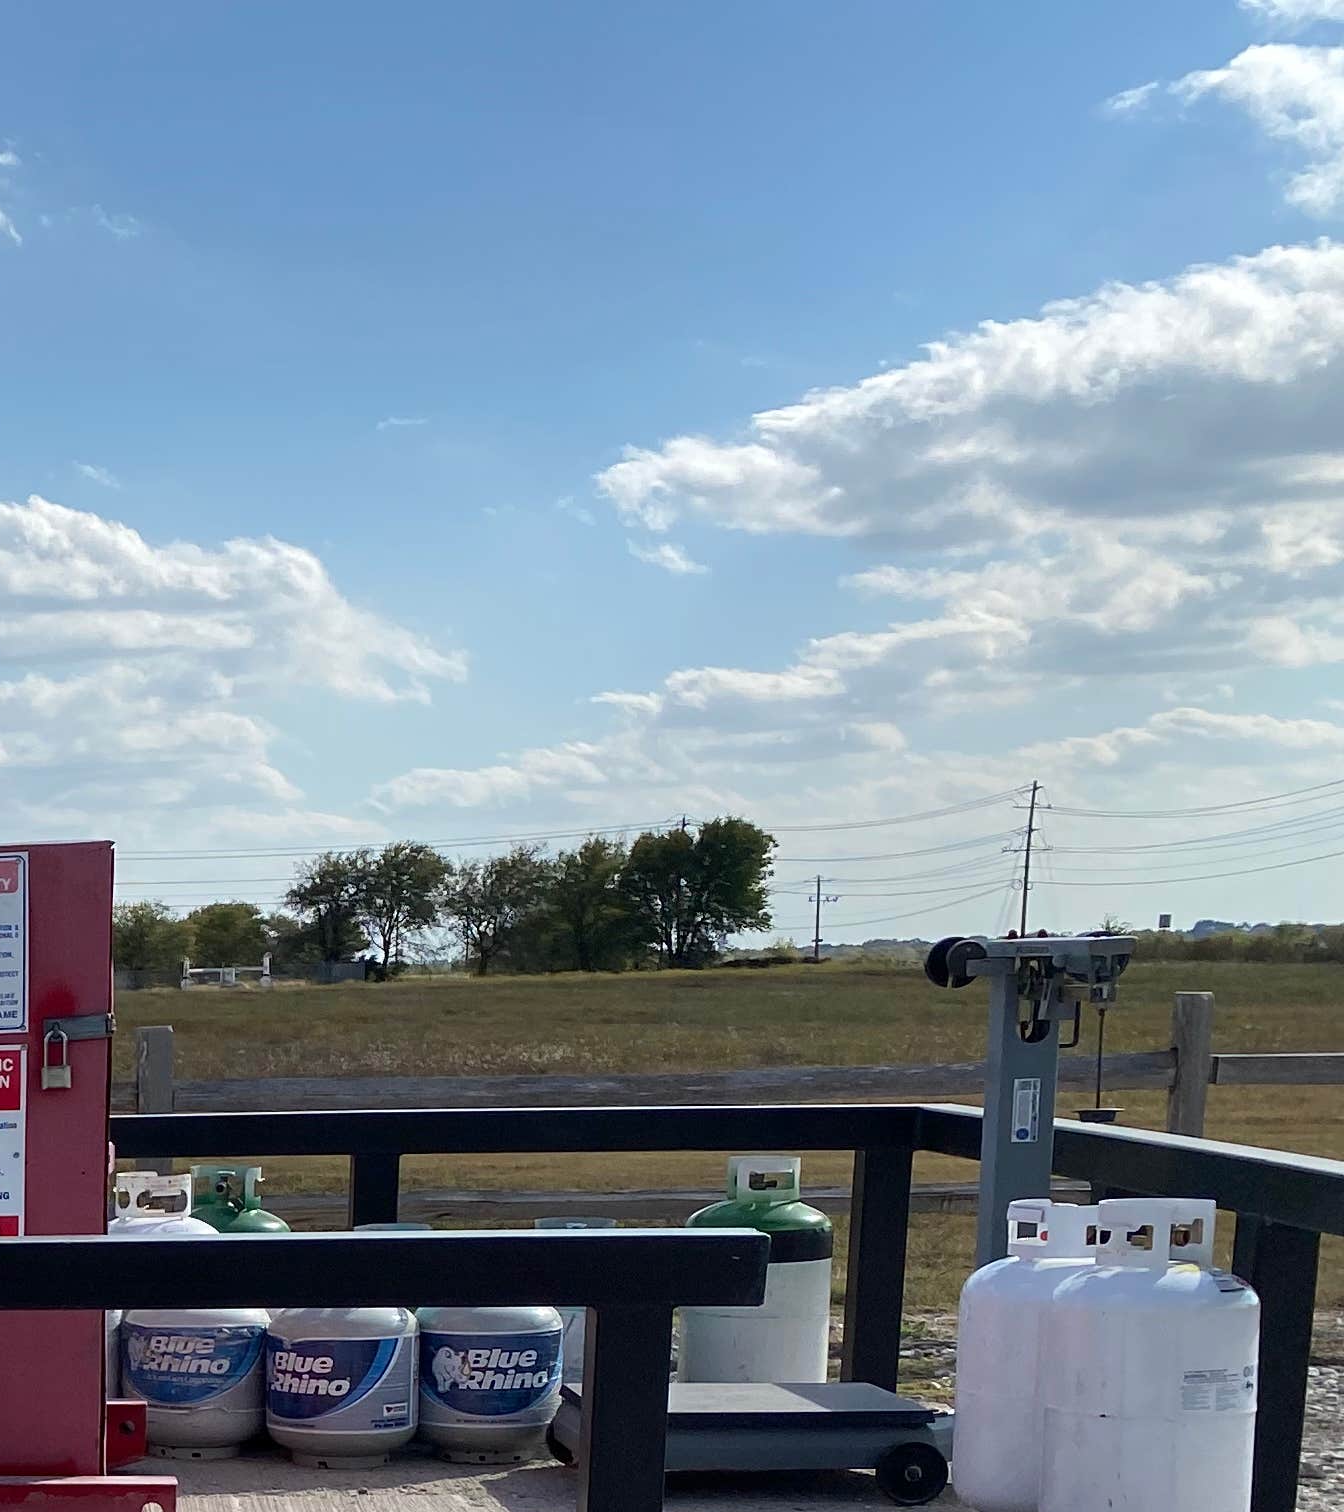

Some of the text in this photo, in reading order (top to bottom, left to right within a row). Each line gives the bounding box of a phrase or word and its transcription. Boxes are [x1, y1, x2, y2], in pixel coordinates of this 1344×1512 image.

[150, 1335, 215, 1354] Blue
[144, 1353, 230, 1374] Rhino
[275, 1352, 333, 1373] Blue
[468, 1349, 537, 1368] Blue
[271, 1371, 350, 1396] Rhino
[459, 1370, 548, 1390] Rhino
